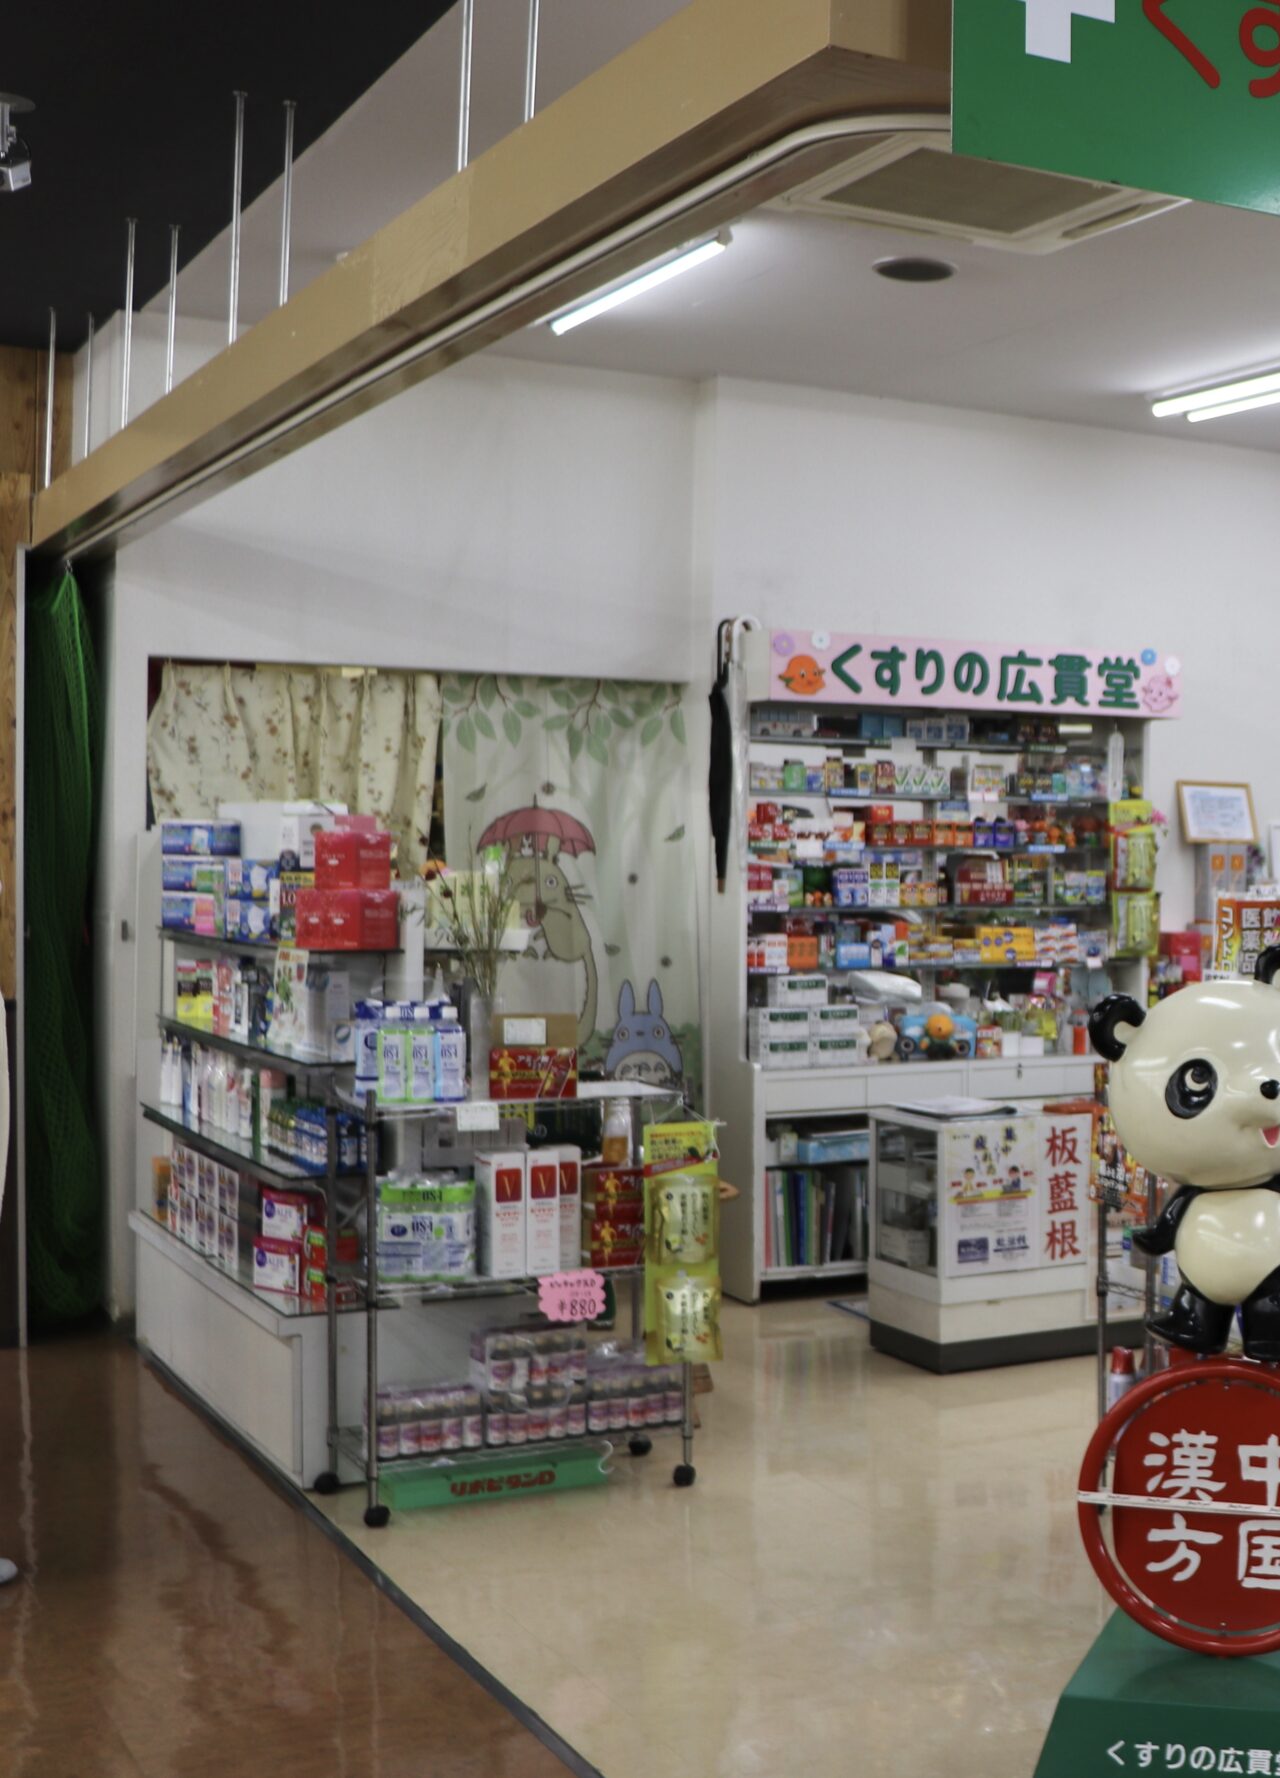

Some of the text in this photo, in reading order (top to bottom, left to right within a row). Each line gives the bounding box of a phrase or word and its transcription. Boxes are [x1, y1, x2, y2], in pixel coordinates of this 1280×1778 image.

[830, 643, 1142, 710] くすりの広貫堂
[1241, 907, 1261, 975] 医薬品
[1045, 1125, 1082, 1262] 板藍根
[559, 1298, 597, 1317] ¥880
[1143, 1428, 1227, 1583] 漢方
